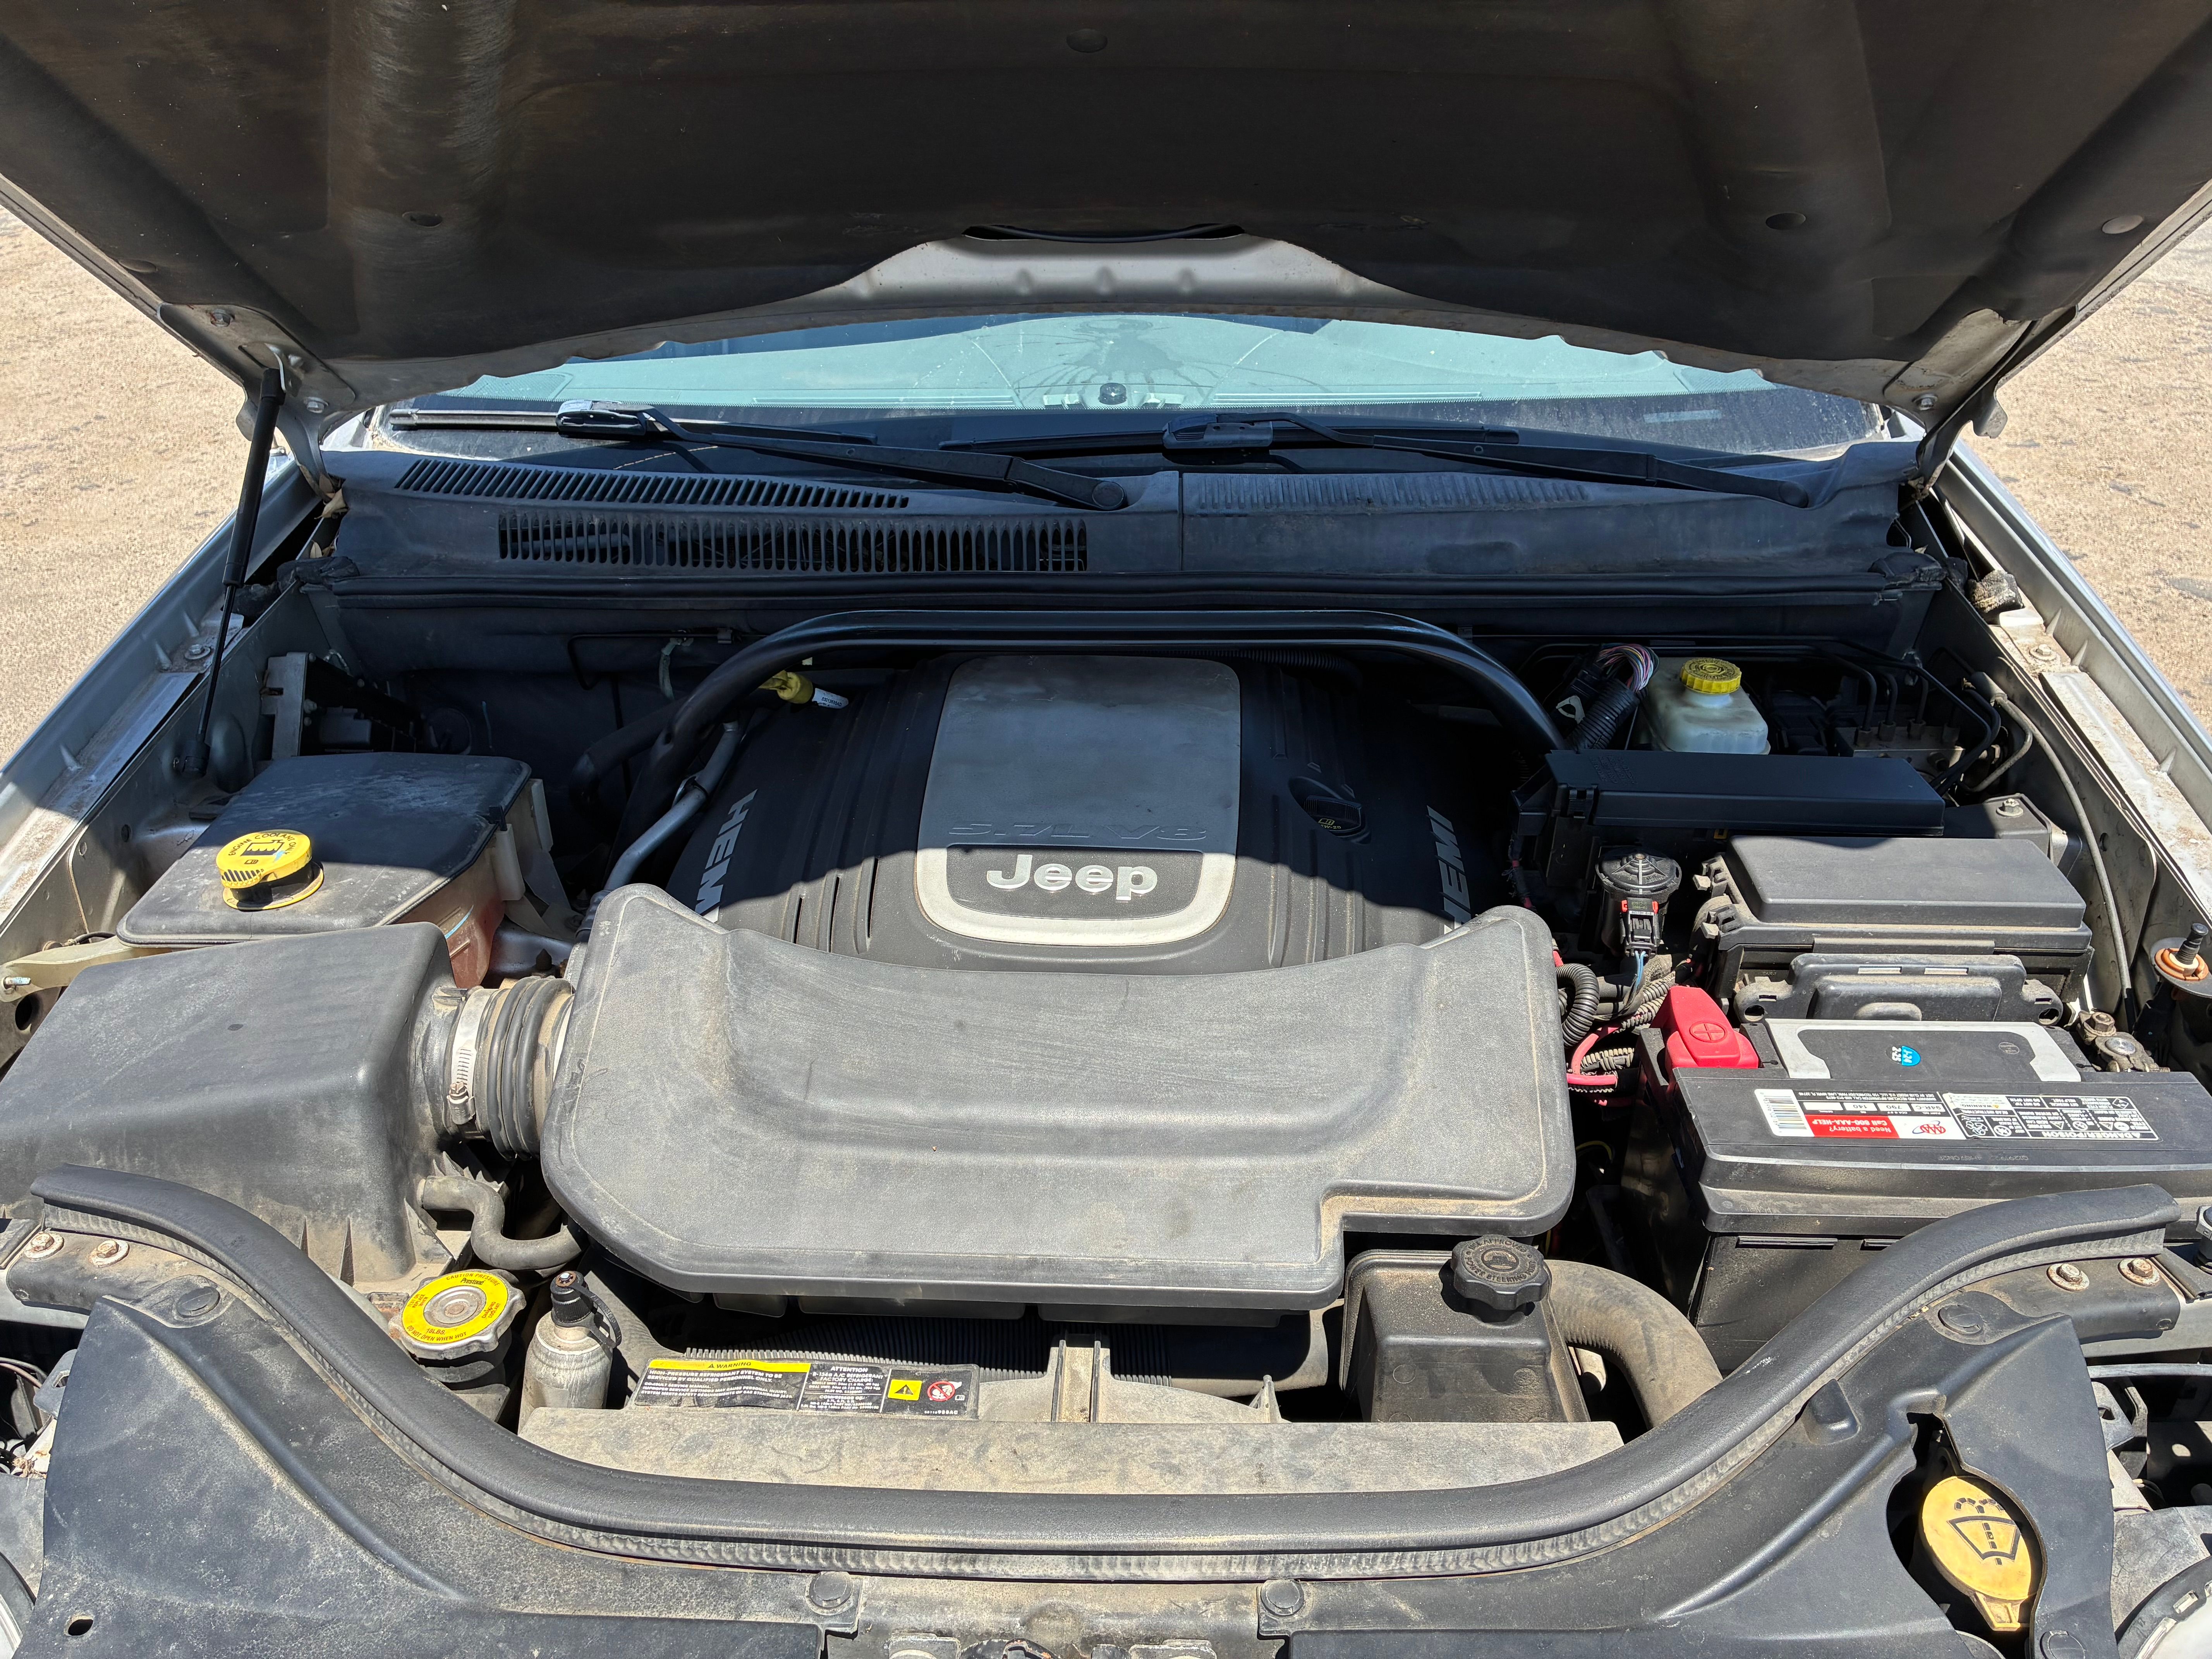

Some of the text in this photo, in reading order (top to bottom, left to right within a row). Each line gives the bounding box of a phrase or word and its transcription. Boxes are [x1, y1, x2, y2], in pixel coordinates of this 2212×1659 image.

[1106, 824, 1206, 841] V8
[228, 839, 252, 855] ENGINE
[283, 842, 296, 855] ONLY
[987, 854, 1157, 900] Jeep
[1921, 1125, 1945, 1134] AAA
[1484, 1239, 1527, 1252] APPROVED
[475, 1274, 500, 1286] PRESSURE
[1486, 1274, 1527, 1283] STEERING
